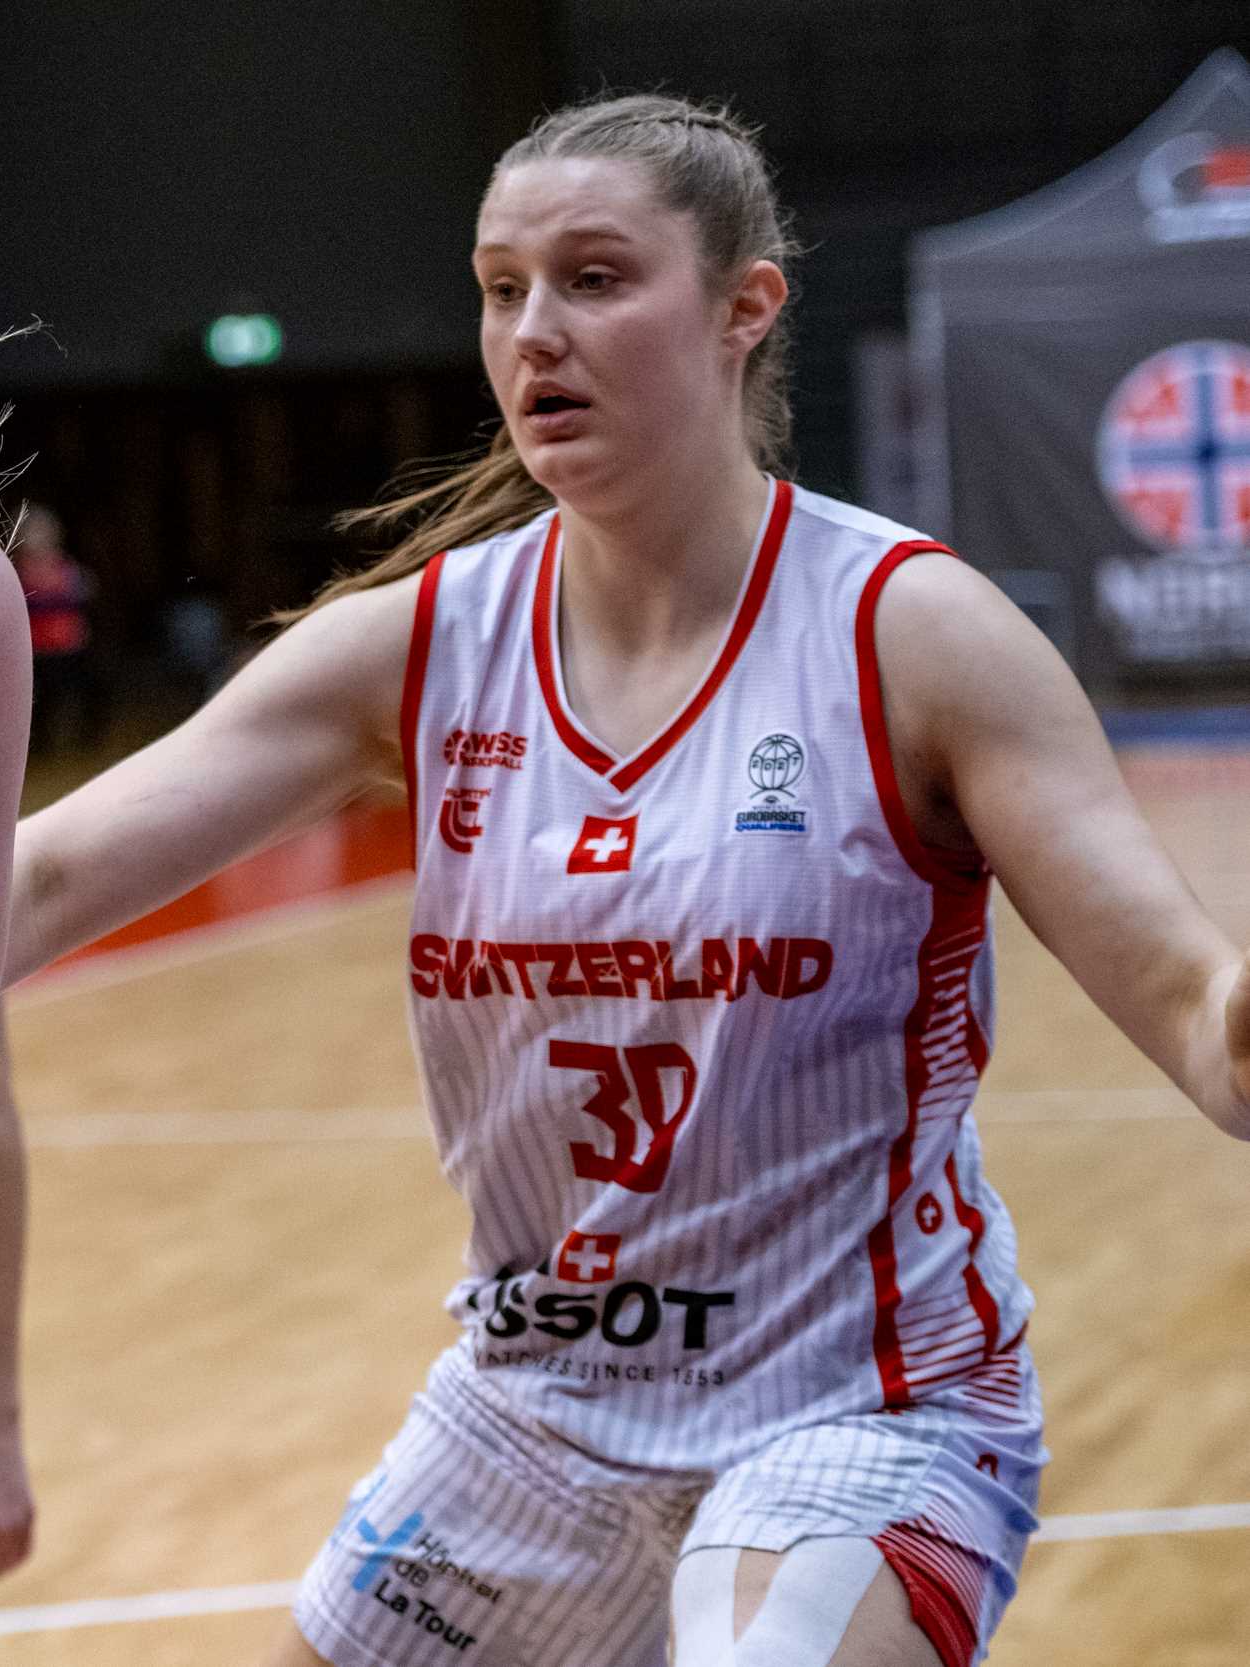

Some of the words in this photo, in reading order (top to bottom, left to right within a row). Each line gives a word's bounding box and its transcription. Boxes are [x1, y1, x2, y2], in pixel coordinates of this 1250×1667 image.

[549, 1040, 698, 1193] 30
[580, 1362, 655, 1384] SINCE
[374, 1578, 409, 1615] La
[414, 1599, 477, 1650] Tour
